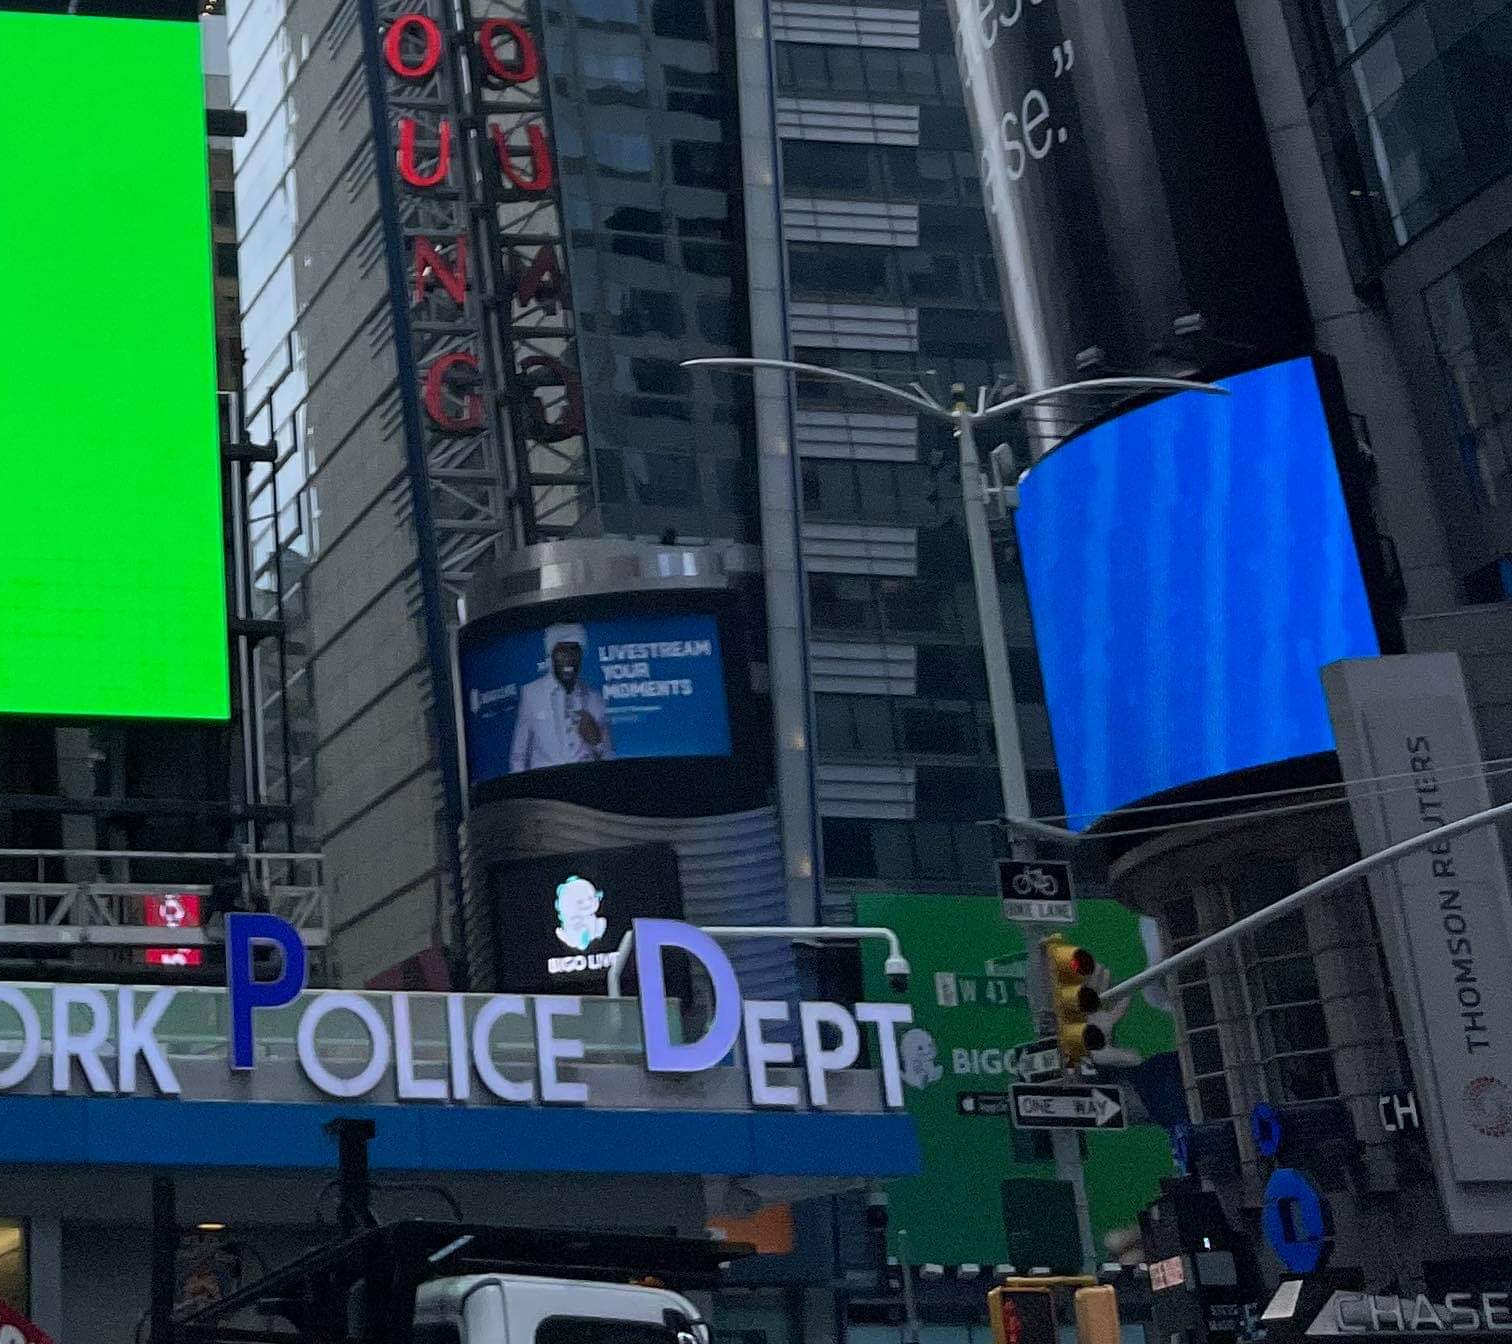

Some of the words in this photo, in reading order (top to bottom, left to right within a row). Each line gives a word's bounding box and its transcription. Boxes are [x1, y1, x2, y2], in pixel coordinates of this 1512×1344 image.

[598, 640, 712, 662] LIVESTREAM
[600, 662, 650, 681] YOUR
[602, 679, 694, 700] MOMENTS
[588, 951, 622, 970] LIV
[1439, 889, 1490, 1054] THOMSON
[1336, 1291, 1512, 1333] CHASE
